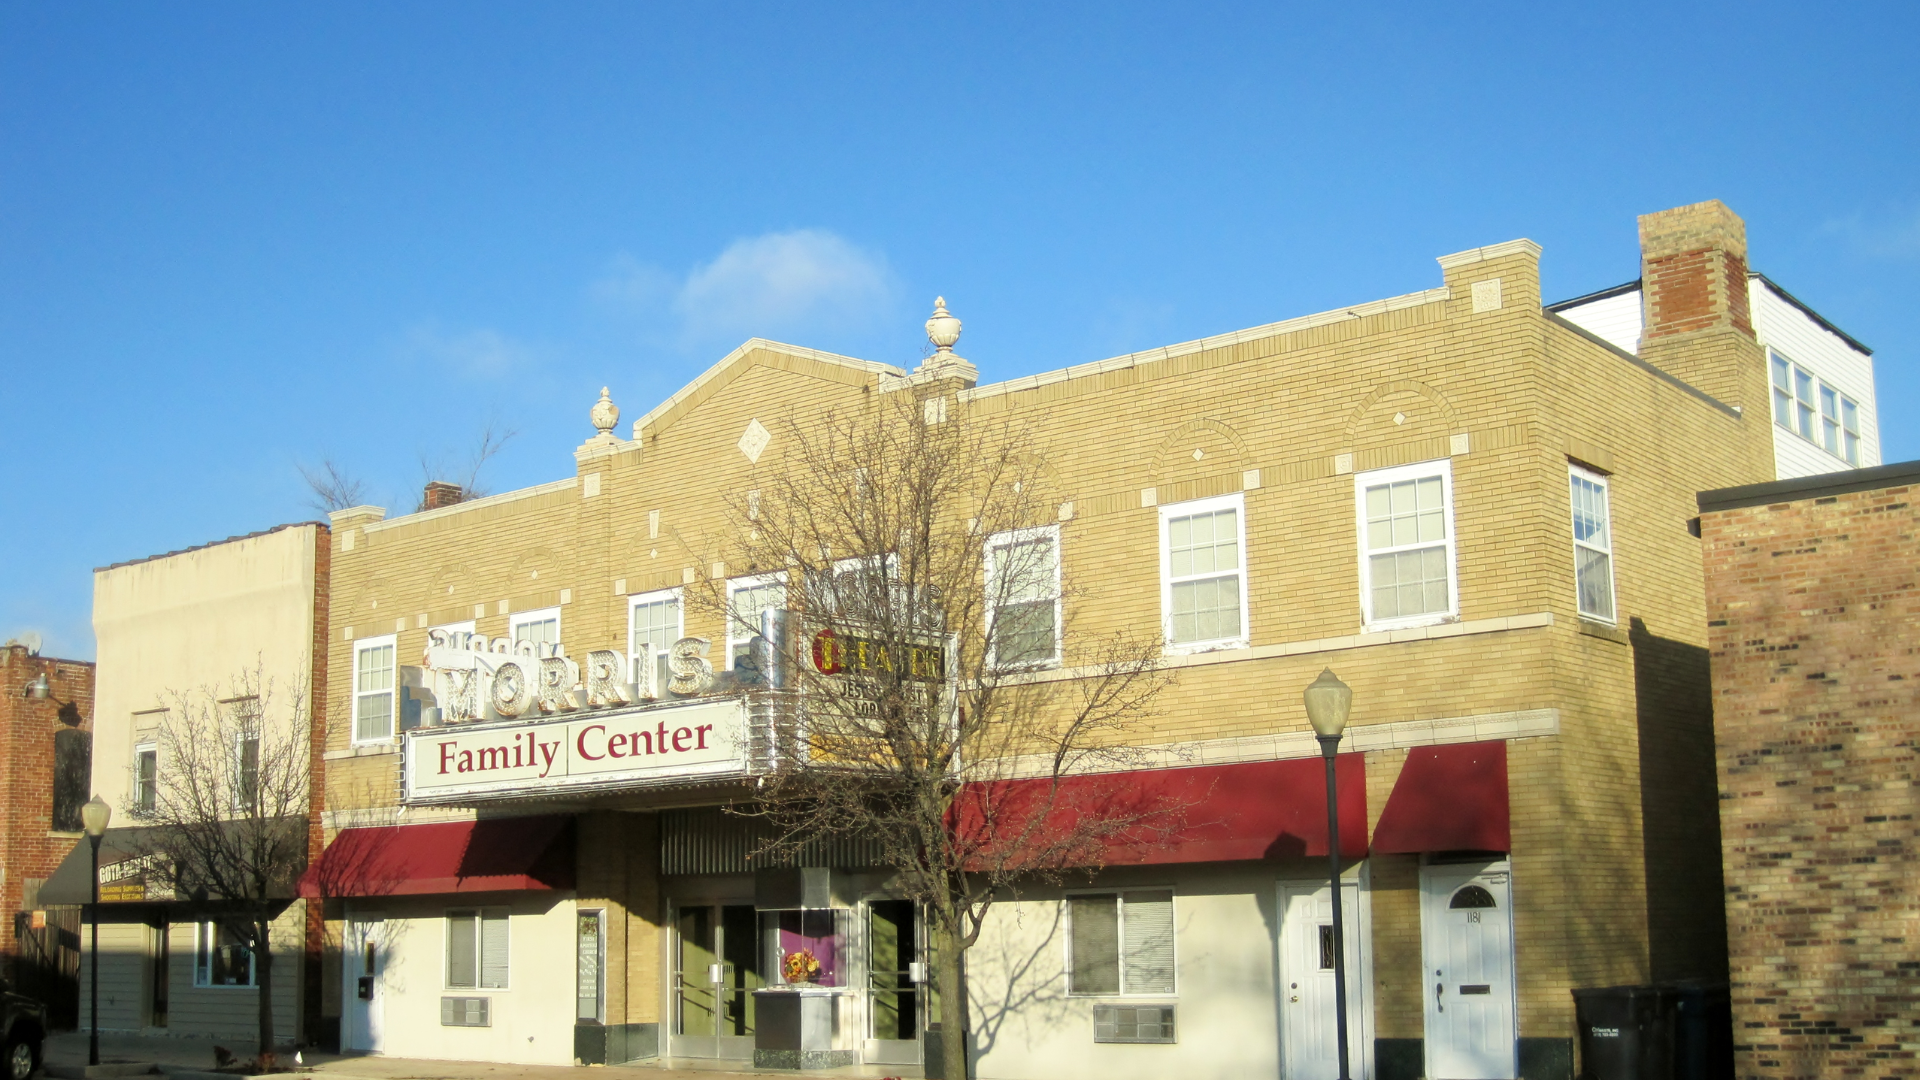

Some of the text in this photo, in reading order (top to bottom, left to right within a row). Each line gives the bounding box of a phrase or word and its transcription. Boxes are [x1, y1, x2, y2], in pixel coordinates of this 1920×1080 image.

[442, 637, 713, 722] MORRIS
[816, 636, 940, 679] THEARE
[437, 720, 713, 778] Family Center
[1467, 911, 1481, 924] 1181
